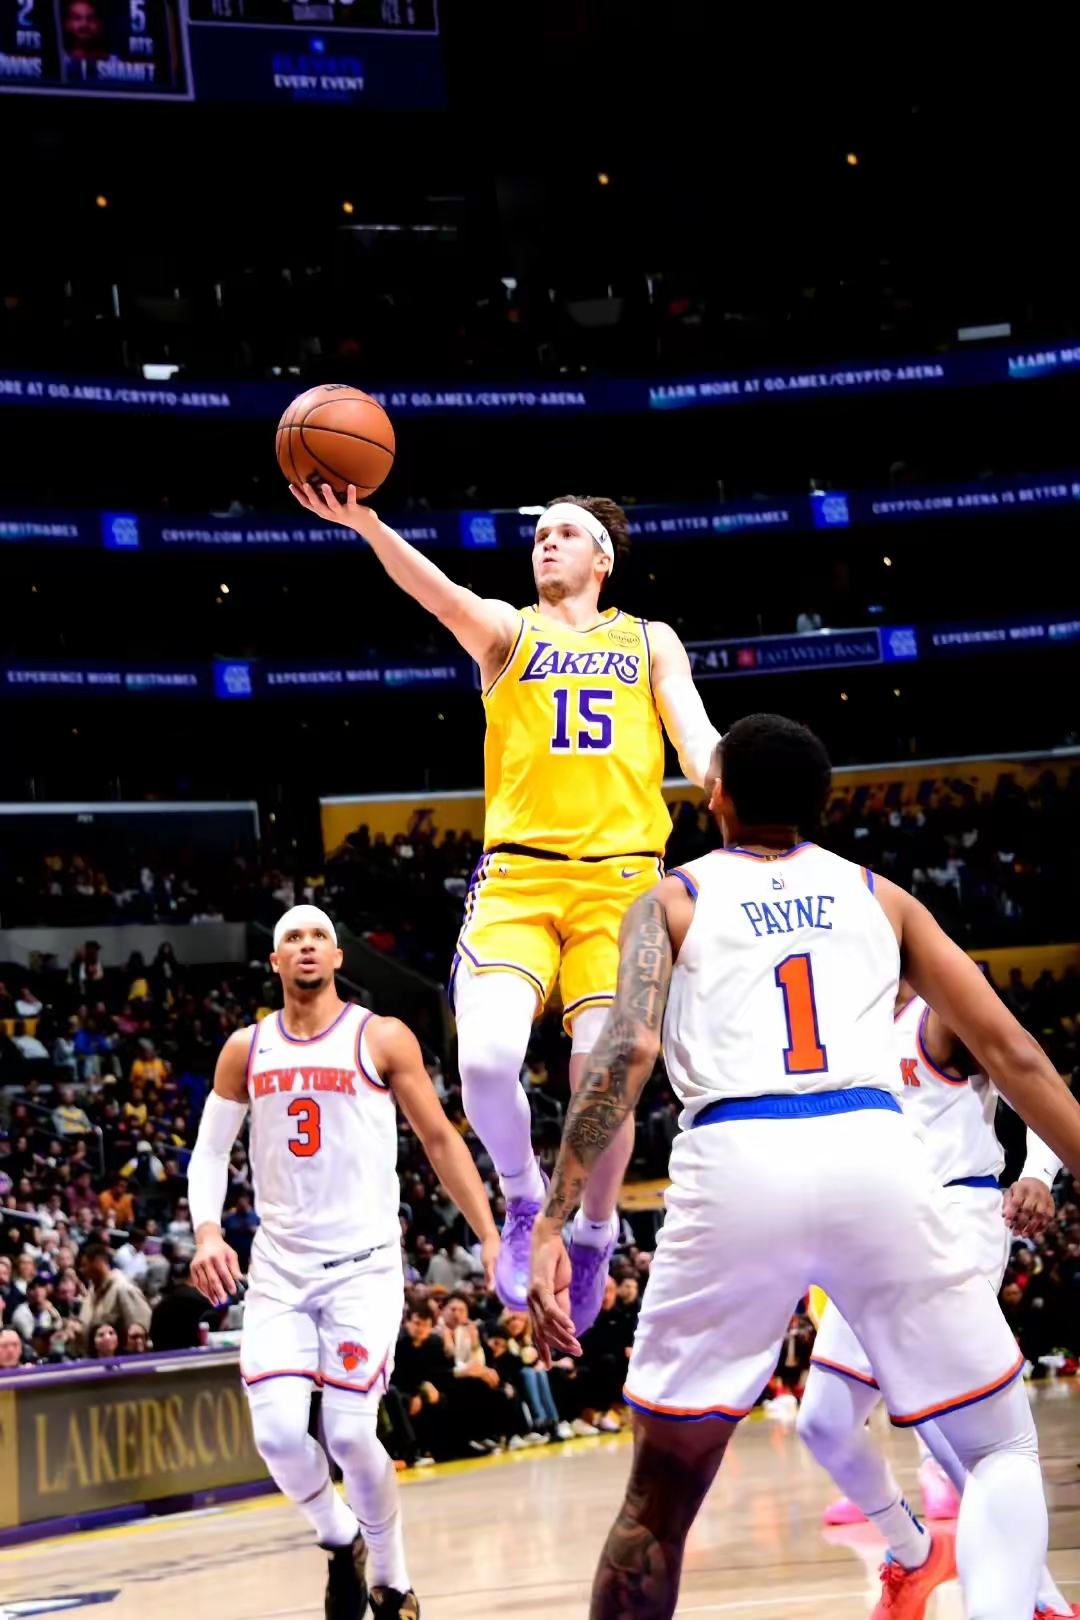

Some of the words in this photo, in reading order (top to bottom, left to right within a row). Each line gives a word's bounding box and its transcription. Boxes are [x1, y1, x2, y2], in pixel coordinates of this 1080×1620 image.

[273, 73, 318, 89] EVERY
[320, 75, 364, 92] EVENT
[1008, 351, 1057, 369] LEARN
[649, 384, 696, 400] LEARN
[699, 380, 740, 396] MORE
[744, 378, 760, 393] AT
[872, 496, 953, 514] CRYPTO.COM
[957, 493, 999, 507] ARENA
[1001, 490, 1016, 504] IS
[1018, 484, 1068, 502] BETTER
[661, 516, 709, 533] BETTER
[246, 530, 290, 543] ARENA
[932, 629, 1006, 646] EXPERIENCE
[1009, 625, 1044, 640] MORE
[518, 641, 640, 684] LAKERS
[7, 670, 84, 684] EXPERIENCE
[267, 670, 343, 684] EXPERIENCE
[550, 687, 614, 753] 15
[740, 895, 835, 937] PAYNE
[774, 952, 829, 1075] 1
[252, 1066, 298, 1099] NEW
[299, 1066, 357, 1096] YORK
[287, 1097, 321, 1157] 3
